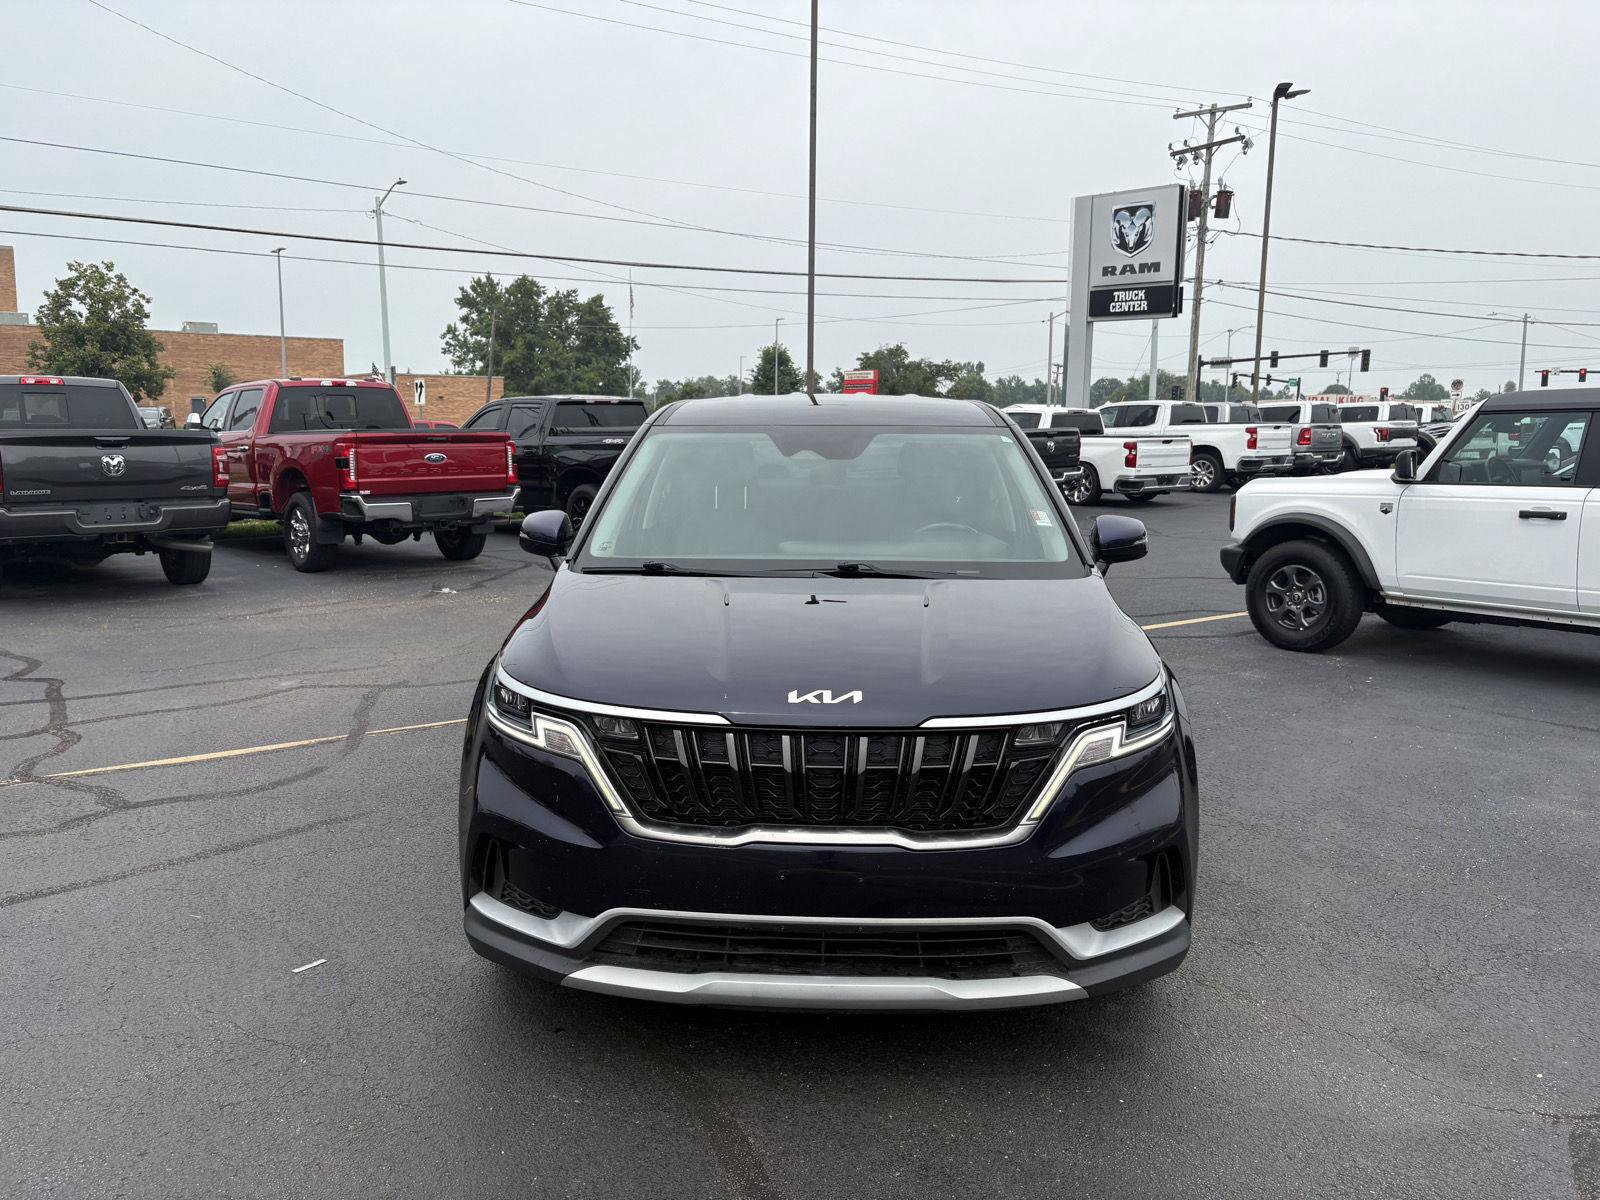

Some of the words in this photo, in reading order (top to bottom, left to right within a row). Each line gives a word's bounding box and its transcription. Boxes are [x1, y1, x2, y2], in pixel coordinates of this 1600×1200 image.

[1102, 262, 1160, 276] RAM
[1113, 290, 1145, 301] TRUCK
[1110, 301, 1147, 312] CENTER
[787, 689, 863, 704] KIA
